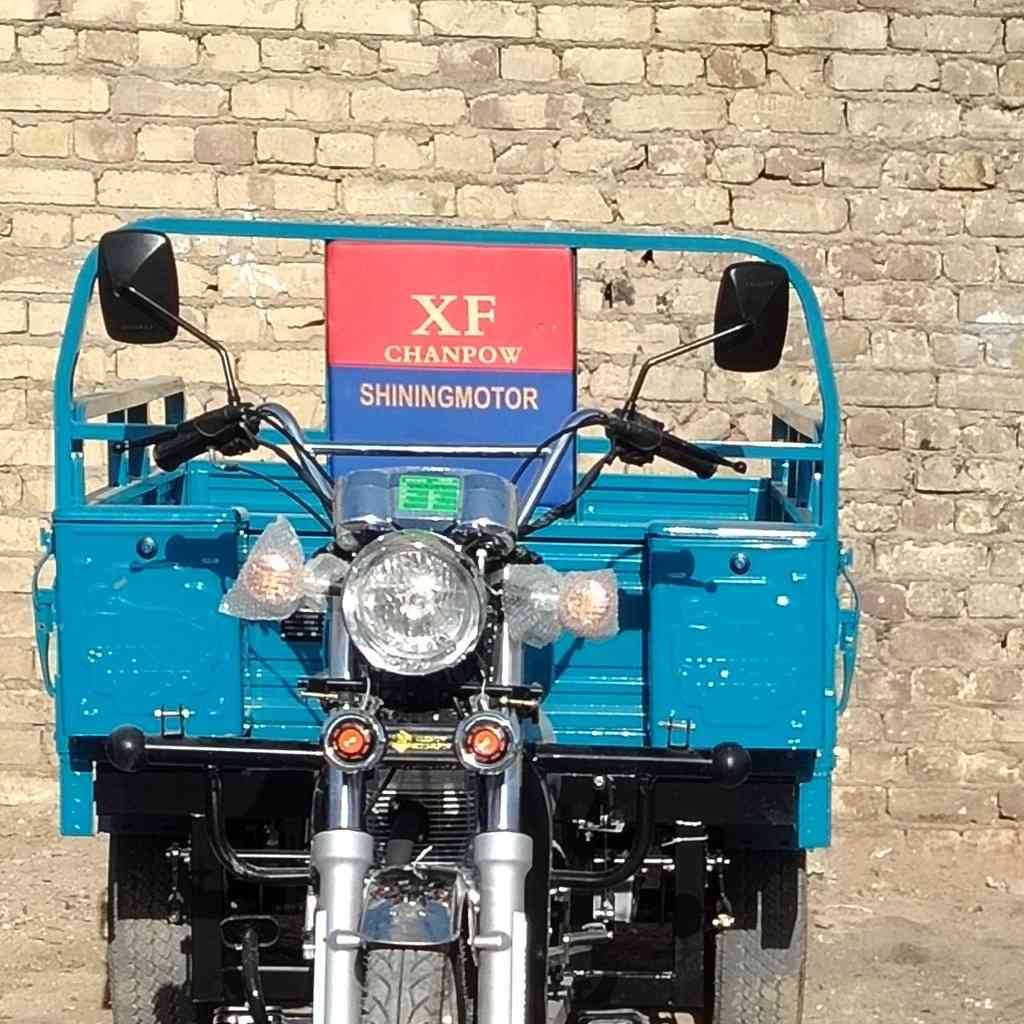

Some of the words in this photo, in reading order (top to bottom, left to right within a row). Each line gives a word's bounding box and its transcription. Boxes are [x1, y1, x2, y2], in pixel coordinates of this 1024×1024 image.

[410, 294, 496, 336] XF
[384, 345, 523, 364] CHANPOW
[359, 383, 539, 410] SHININGMOTOR
